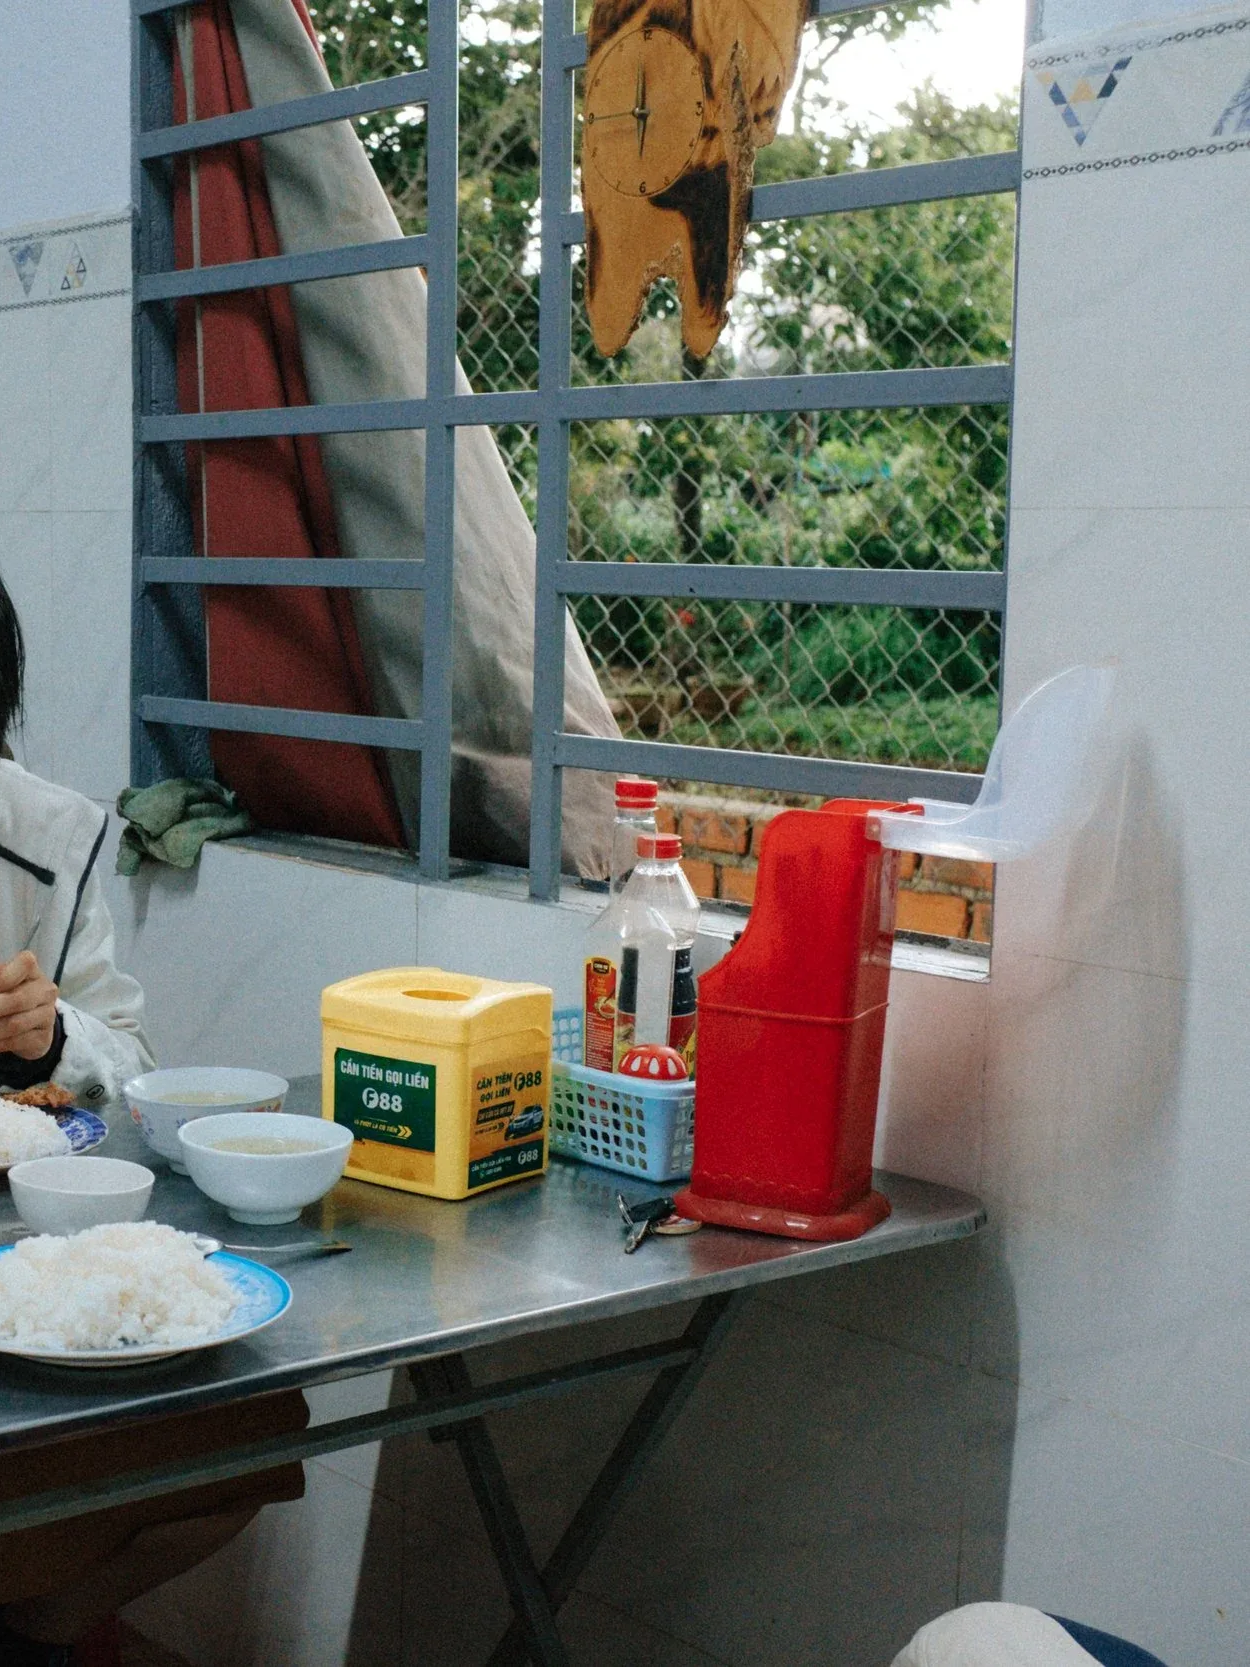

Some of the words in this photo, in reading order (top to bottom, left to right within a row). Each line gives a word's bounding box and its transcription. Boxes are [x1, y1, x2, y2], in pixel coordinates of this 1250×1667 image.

[696, 101, 704, 116] 3
[639, 181, 646, 193] 6
[385, 1069, 403, 1087] GỌI
[514, 1070, 542, 1091] F88
[362, 1087, 403, 1113] F88
